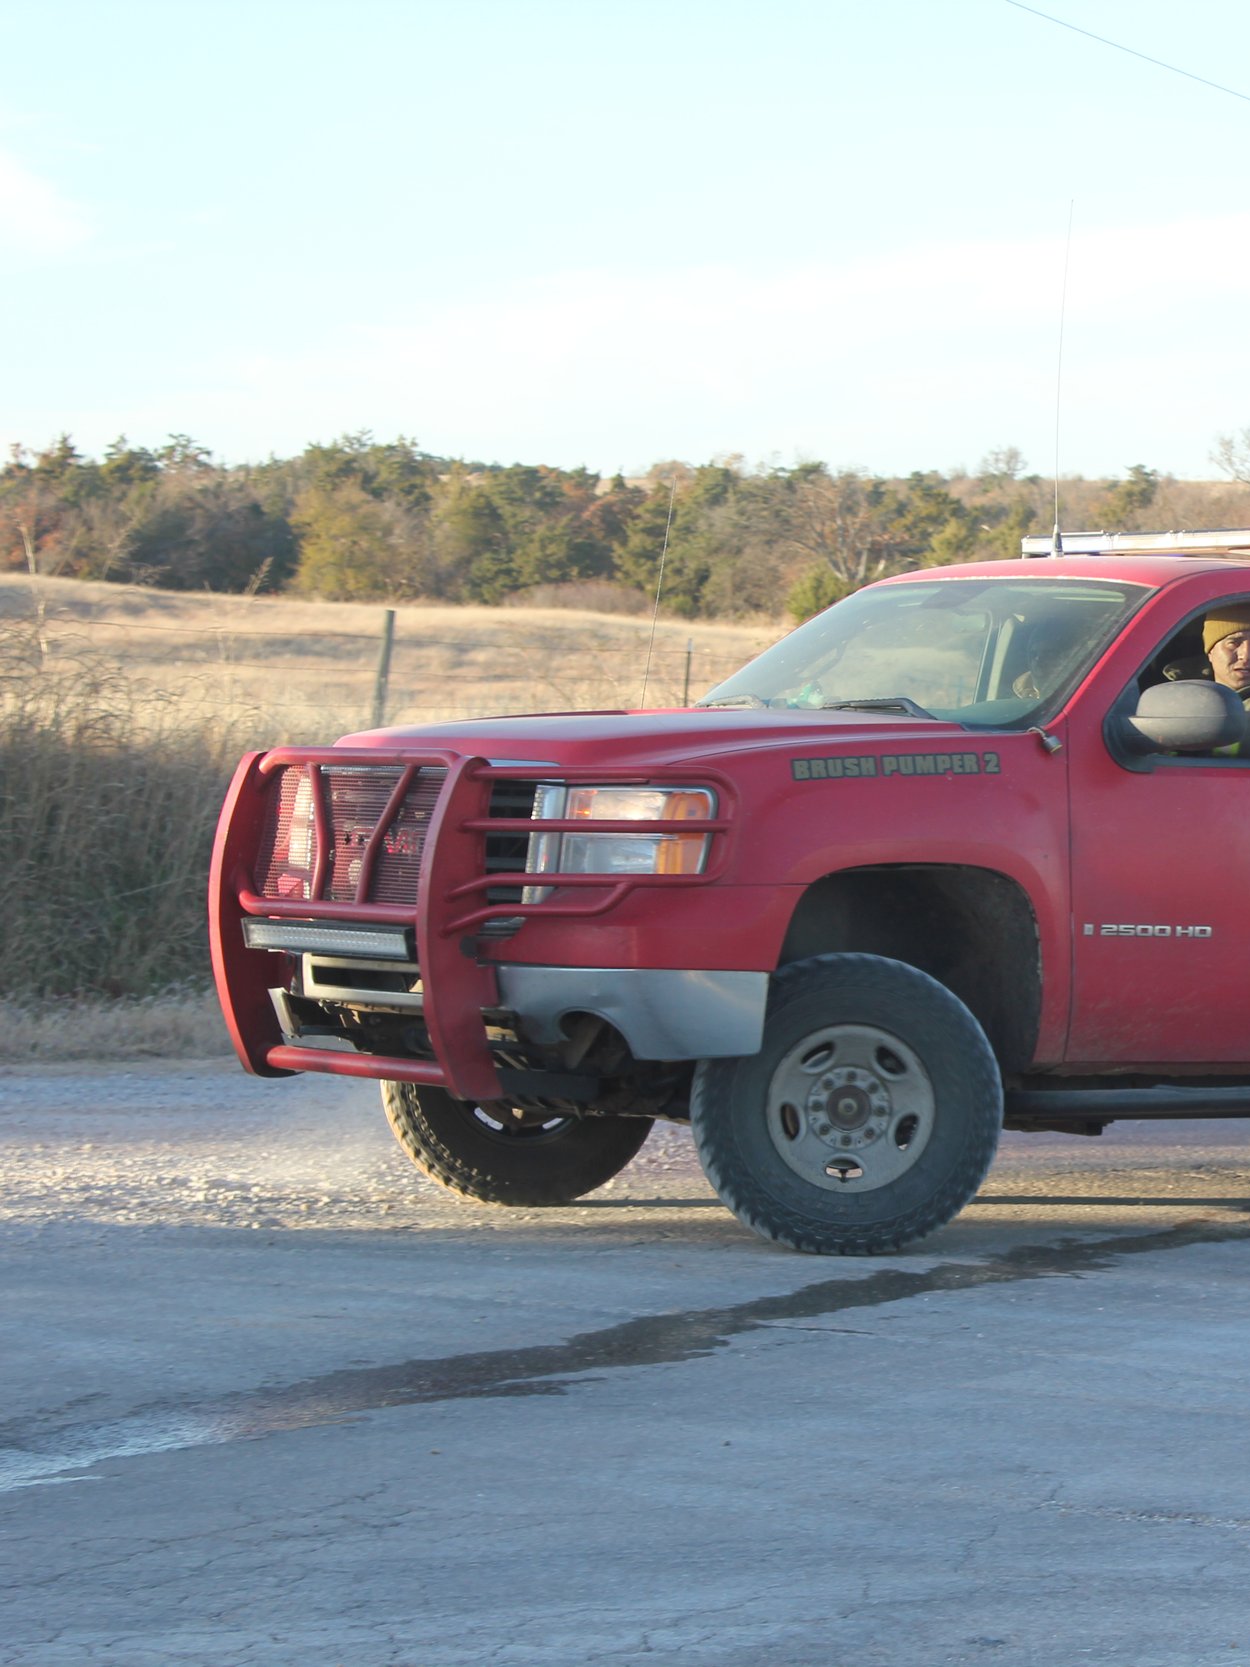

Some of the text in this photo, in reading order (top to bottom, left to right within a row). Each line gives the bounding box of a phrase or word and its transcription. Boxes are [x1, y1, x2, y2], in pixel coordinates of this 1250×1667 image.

[792, 752, 1000, 780] BRUSH PUMPER 2
[1100, 924, 1212, 937] 2500 HD
